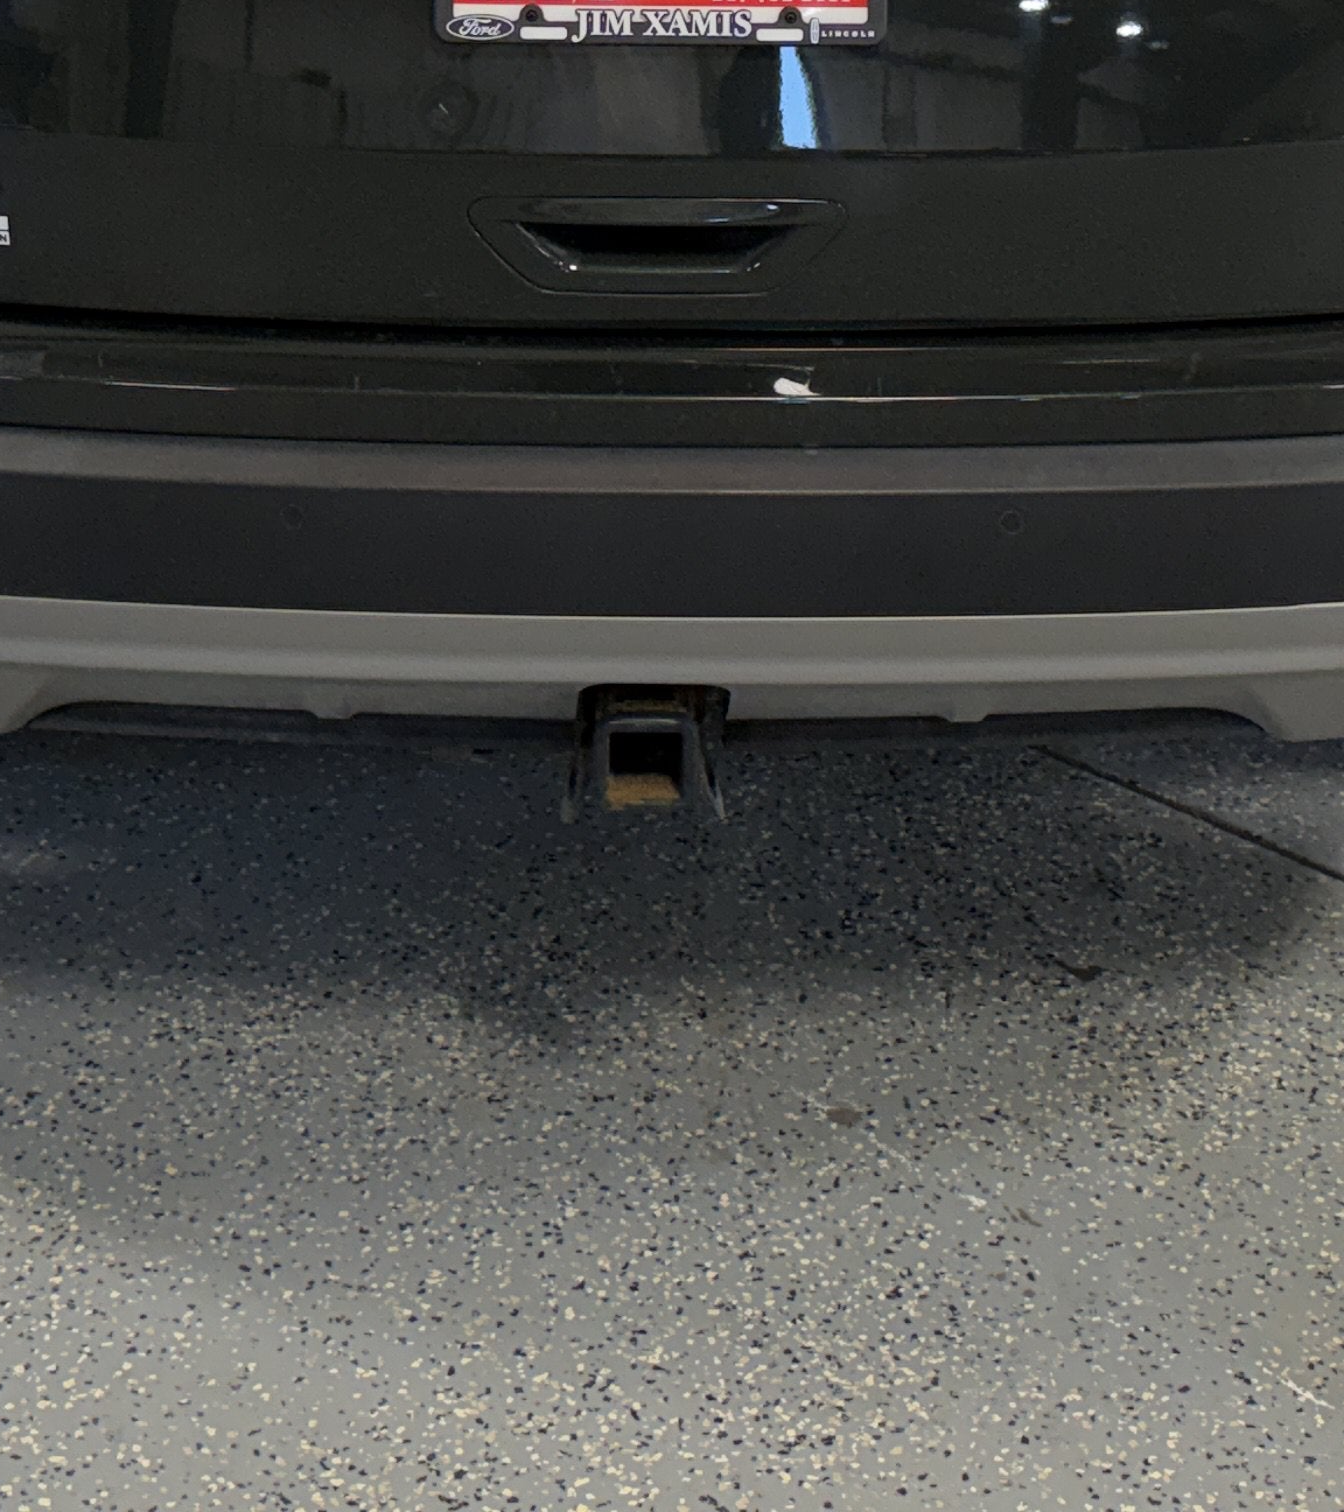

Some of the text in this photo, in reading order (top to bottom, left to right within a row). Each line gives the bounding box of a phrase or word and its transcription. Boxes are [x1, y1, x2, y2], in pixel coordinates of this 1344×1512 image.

[459, 18, 501, 36] Ford
[571, 9, 752, 43] JIM XAMIS
